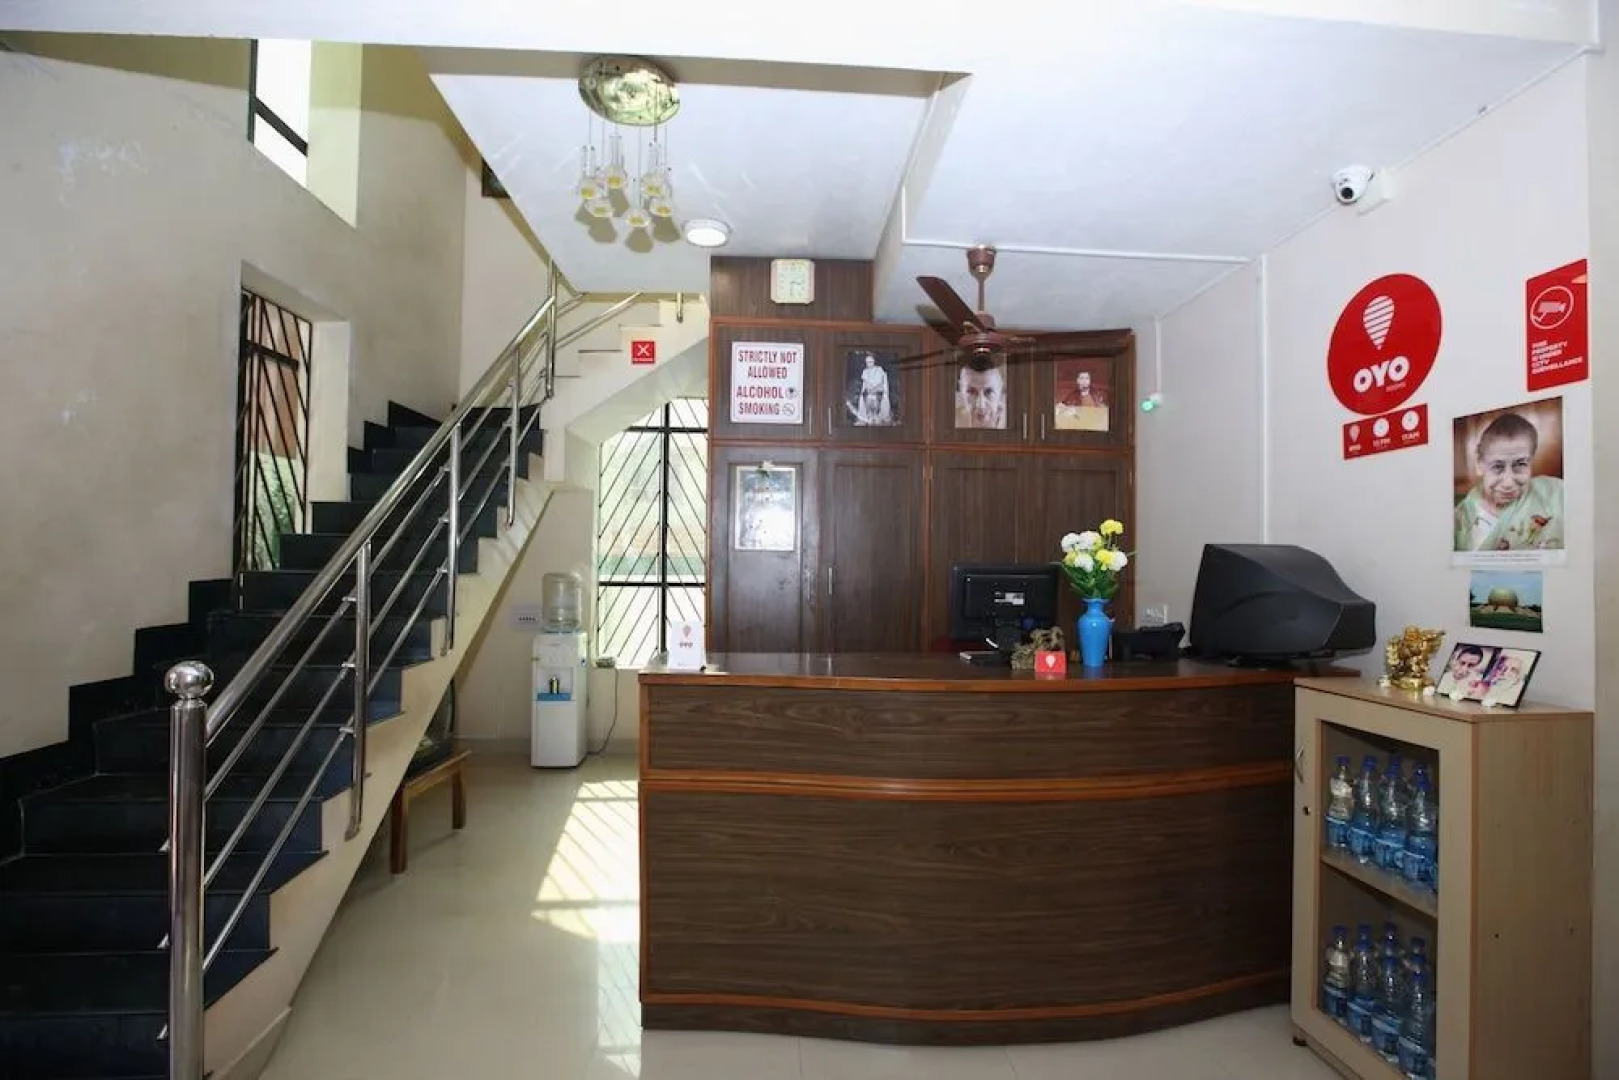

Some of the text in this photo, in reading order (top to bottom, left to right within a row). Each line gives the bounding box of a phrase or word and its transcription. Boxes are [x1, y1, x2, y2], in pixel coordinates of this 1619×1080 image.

[738, 350, 797, 363] STRICTLY NOT
[748, 366, 787, 379] ALLOWED
[1353, 355, 1409, 393] OYO
[737, 386, 784, 398] ALCOHOL
[739, 402, 779, 415] SMOKING
